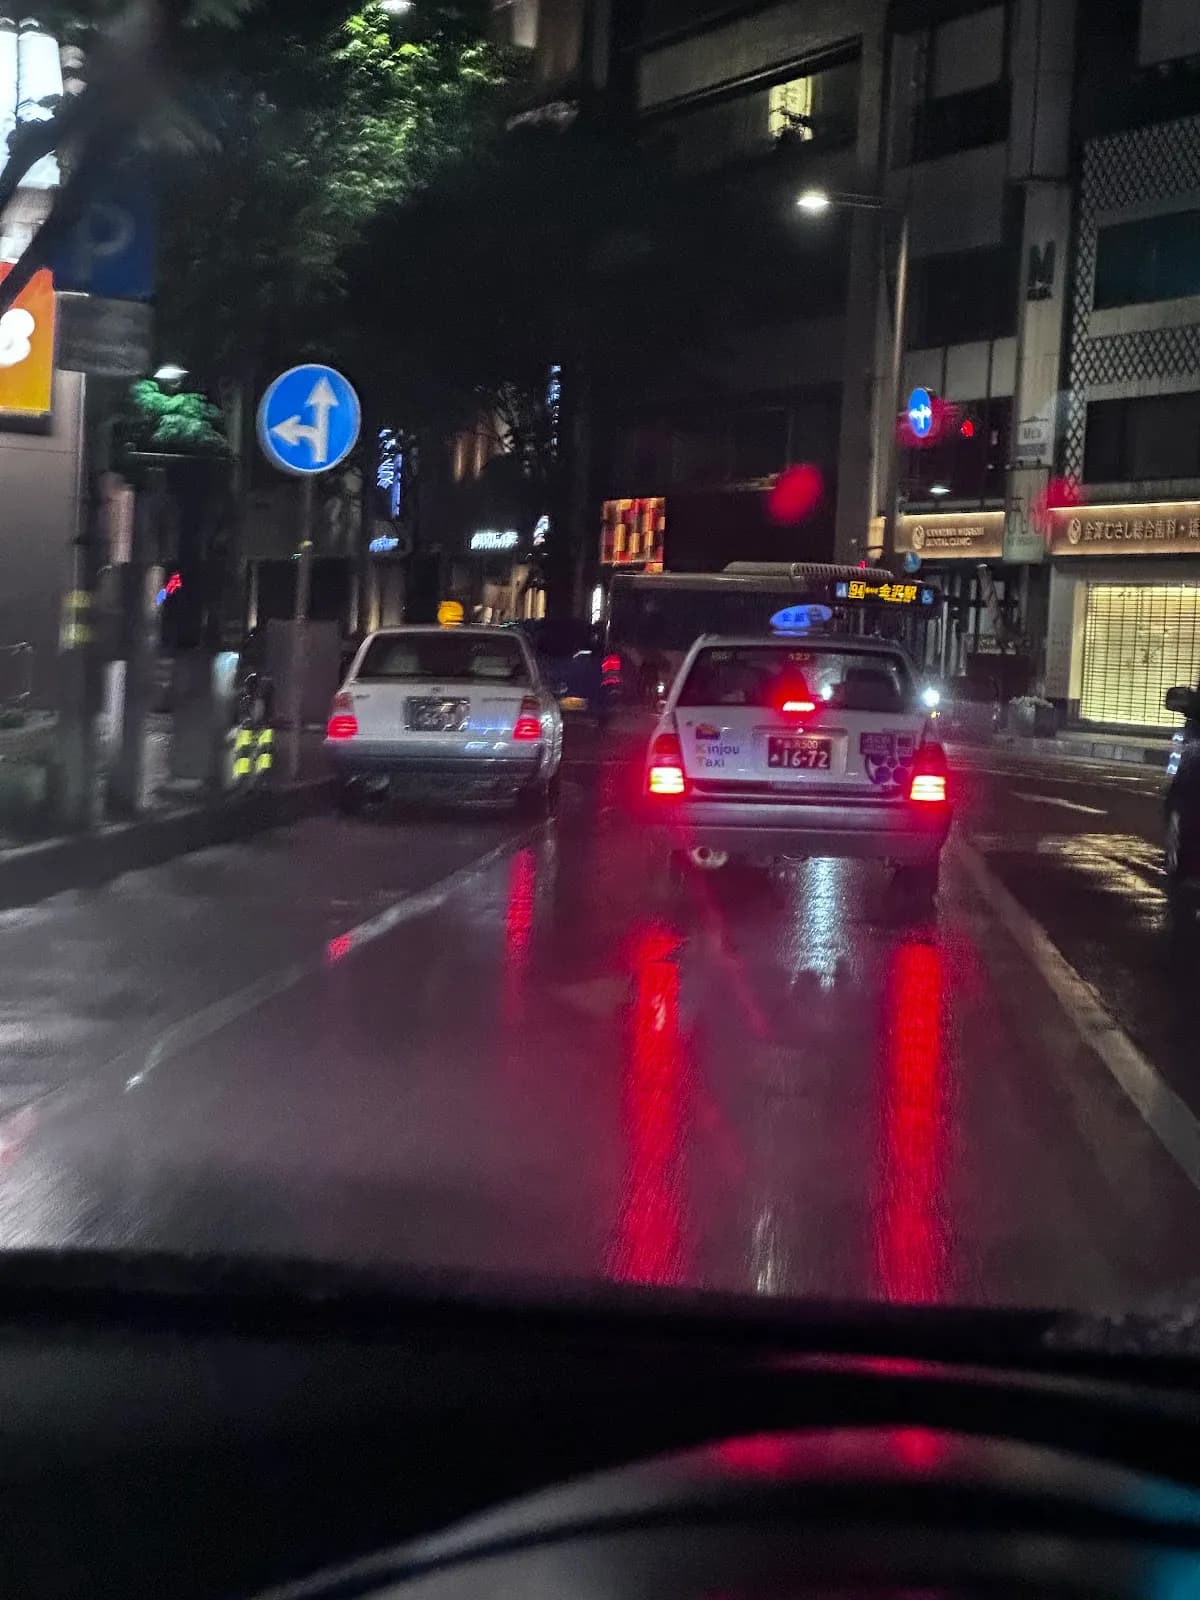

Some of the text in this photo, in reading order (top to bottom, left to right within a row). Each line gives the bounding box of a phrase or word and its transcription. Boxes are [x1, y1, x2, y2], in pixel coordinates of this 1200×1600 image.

[696, 743, 740, 756] Kinjou
[696, 756, 725, 768] Taxi
[783, 749, 829, 768] 16-72
